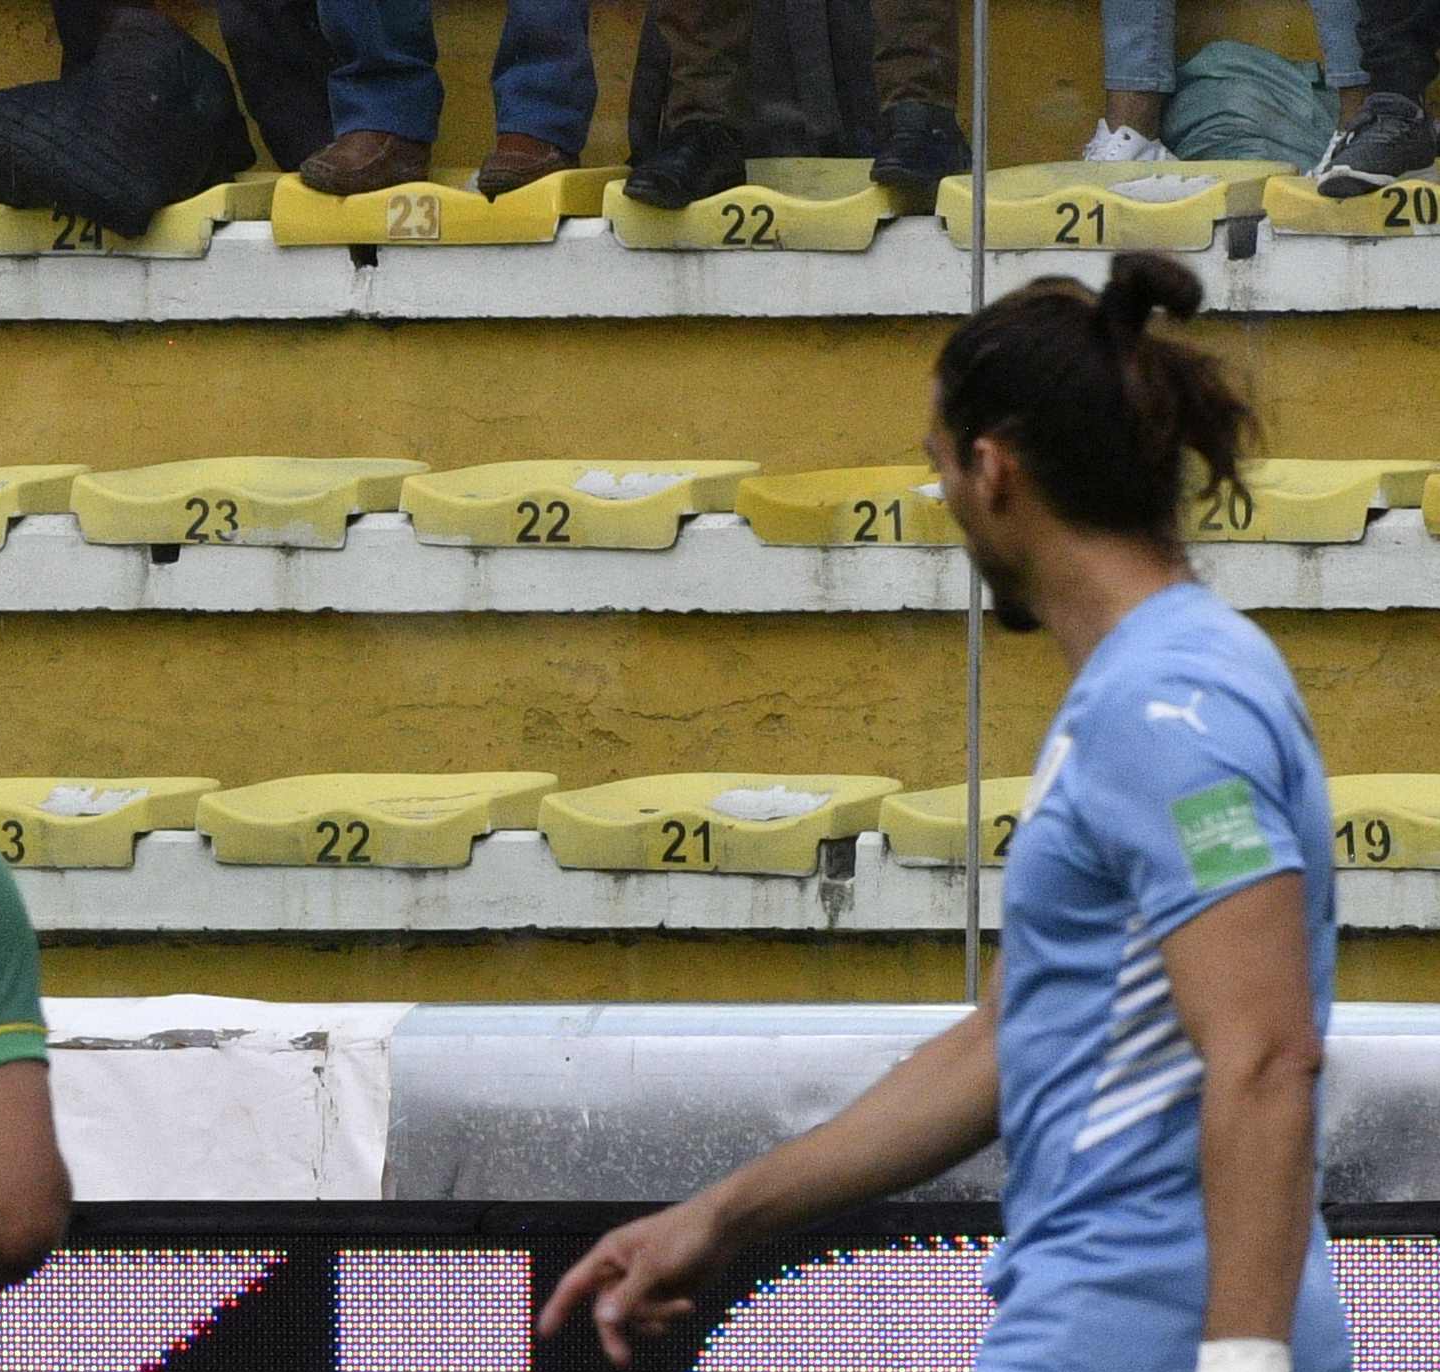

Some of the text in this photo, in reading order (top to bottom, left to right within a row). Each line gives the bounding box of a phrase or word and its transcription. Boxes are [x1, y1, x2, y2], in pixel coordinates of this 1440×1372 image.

[388, 194, 439, 237] 23
[720, 202, 777, 246] 22
[1053, 200, 1106, 244] 21
[1382, 185, 1440, 227] 20
[50, 207, 105, 250] 24
[183, 496, 240, 542] 23
[515, 499, 572, 543] 22
[852, 498, 903, 543] 21
[1198, 482, 1253, 532] 20
[314, 819, 371, 864] 22
[660, 819, 714, 864] 21
[992, 814, 1018, 858] 2
[1334, 818, 1393, 863] 19
